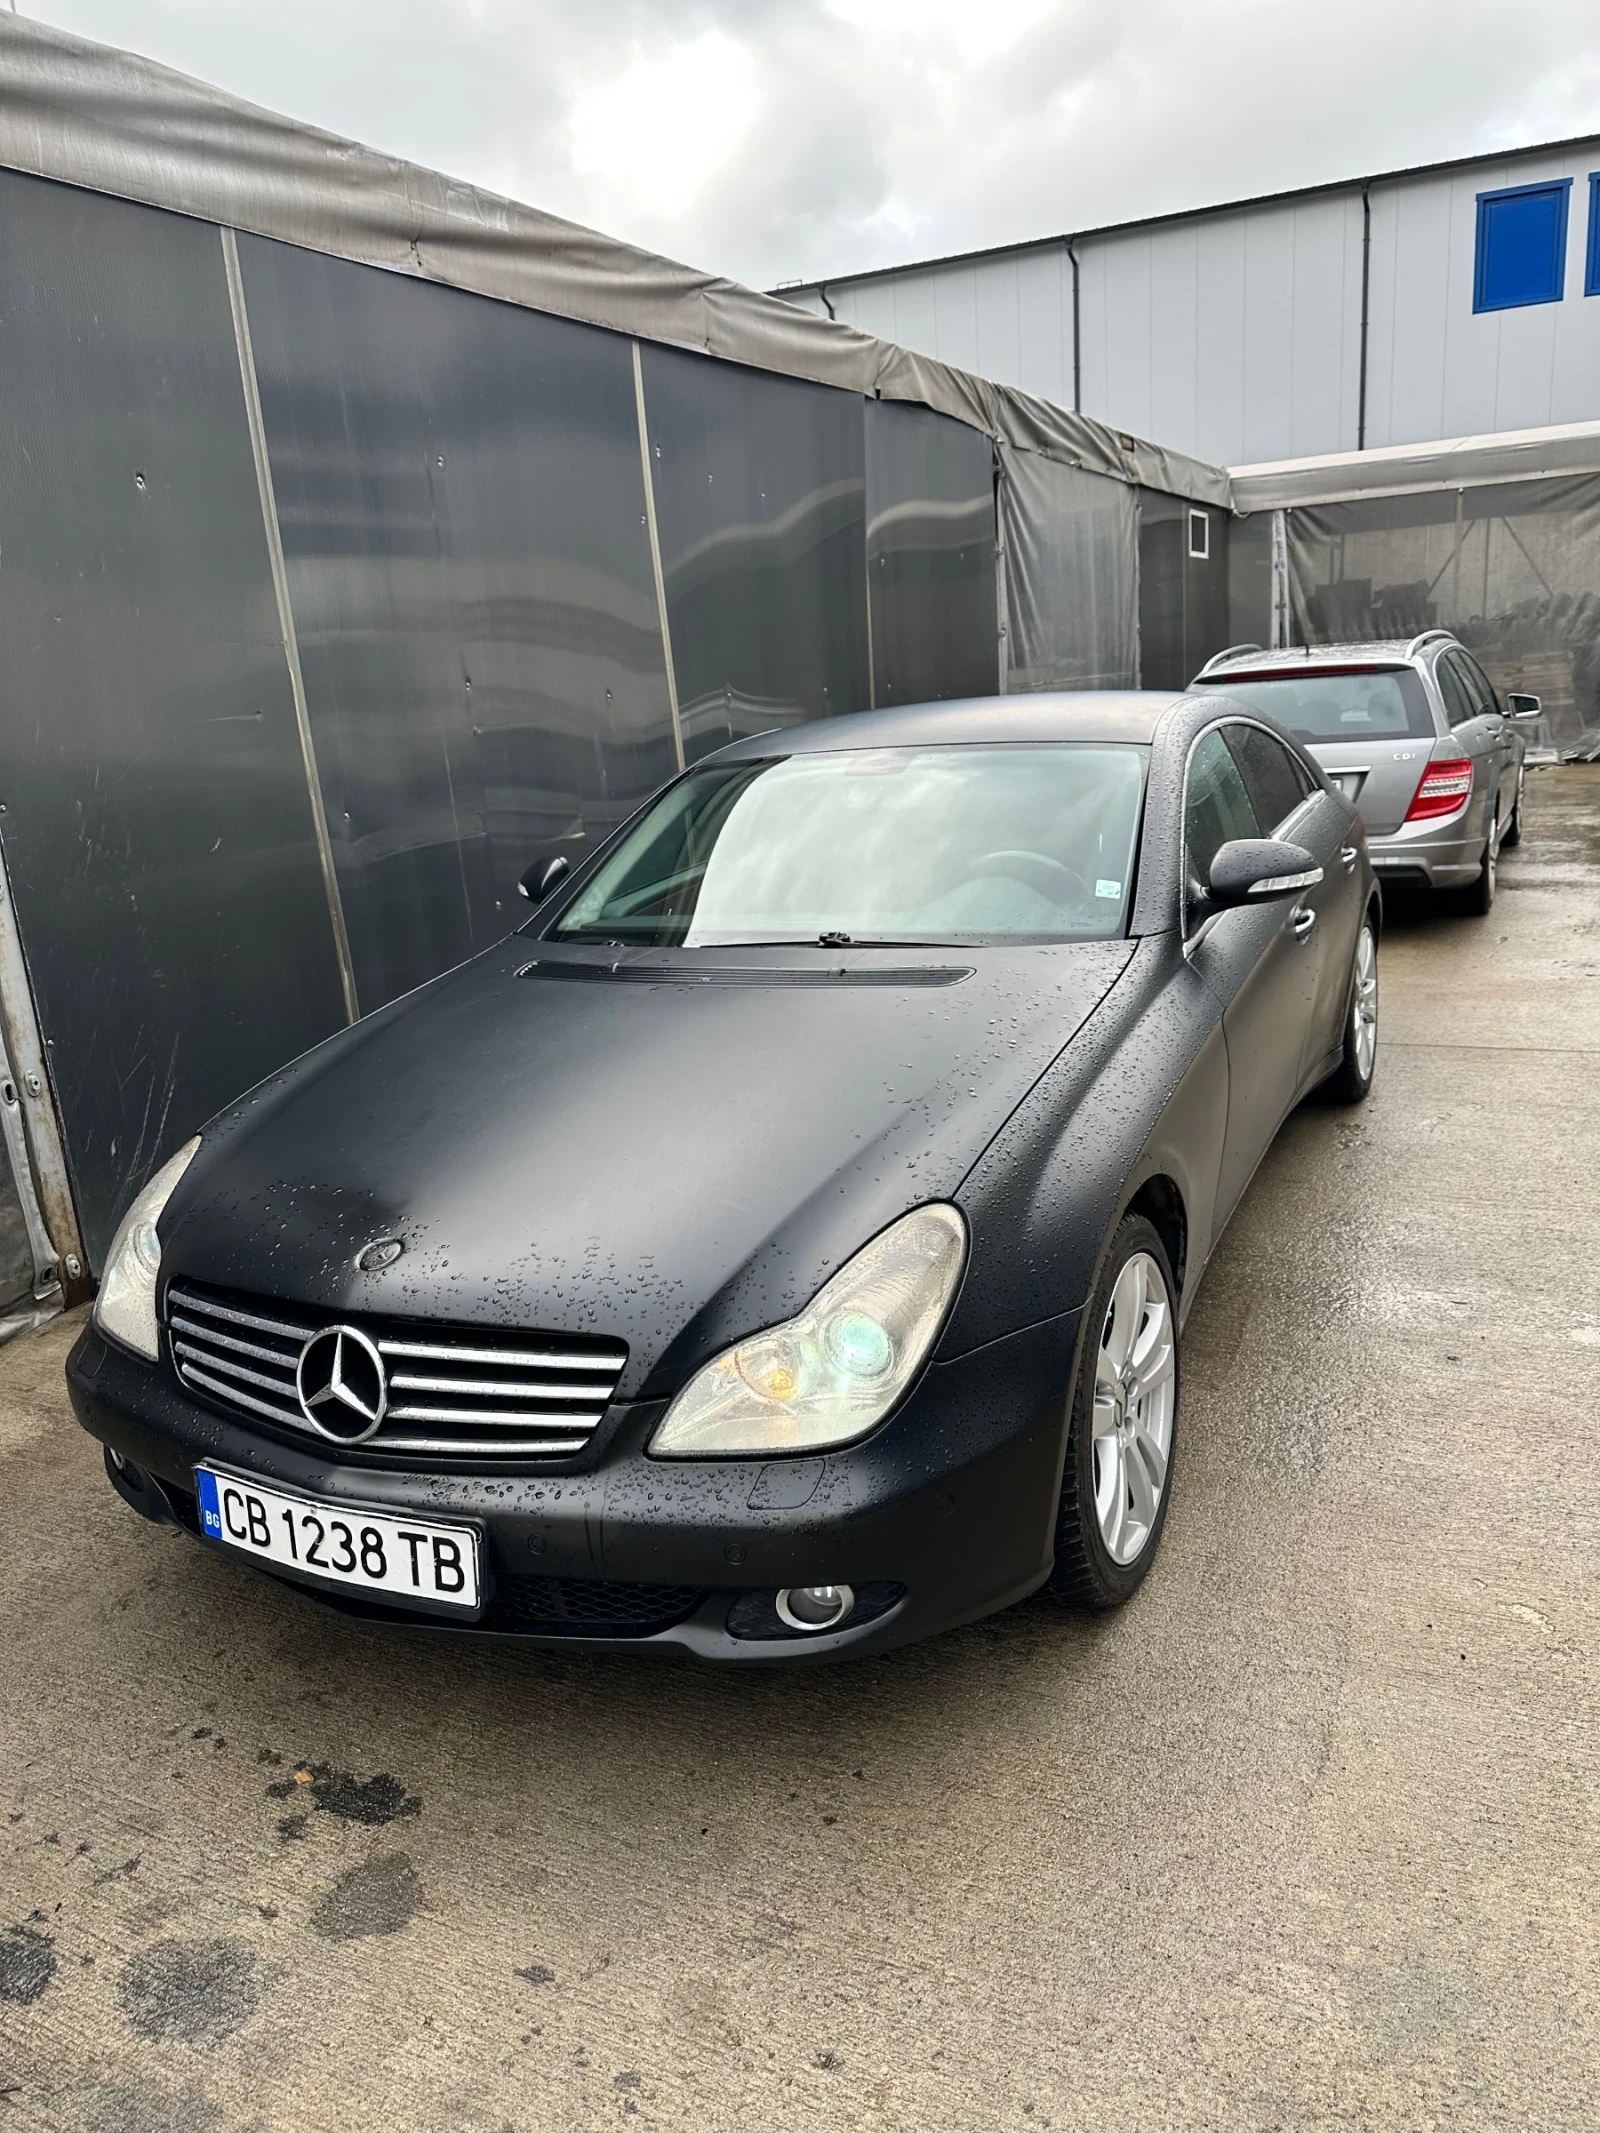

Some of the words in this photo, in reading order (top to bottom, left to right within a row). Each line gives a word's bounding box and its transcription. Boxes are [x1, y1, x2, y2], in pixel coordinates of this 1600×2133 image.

[1393, 752, 1416, 761] CDI
[205, 1509, 220, 1528] BG
[223, 1488, 271, 1548] CB
[281, 1508, 388, 1579] 1238
[397, 1530, 465, 1593] TB
